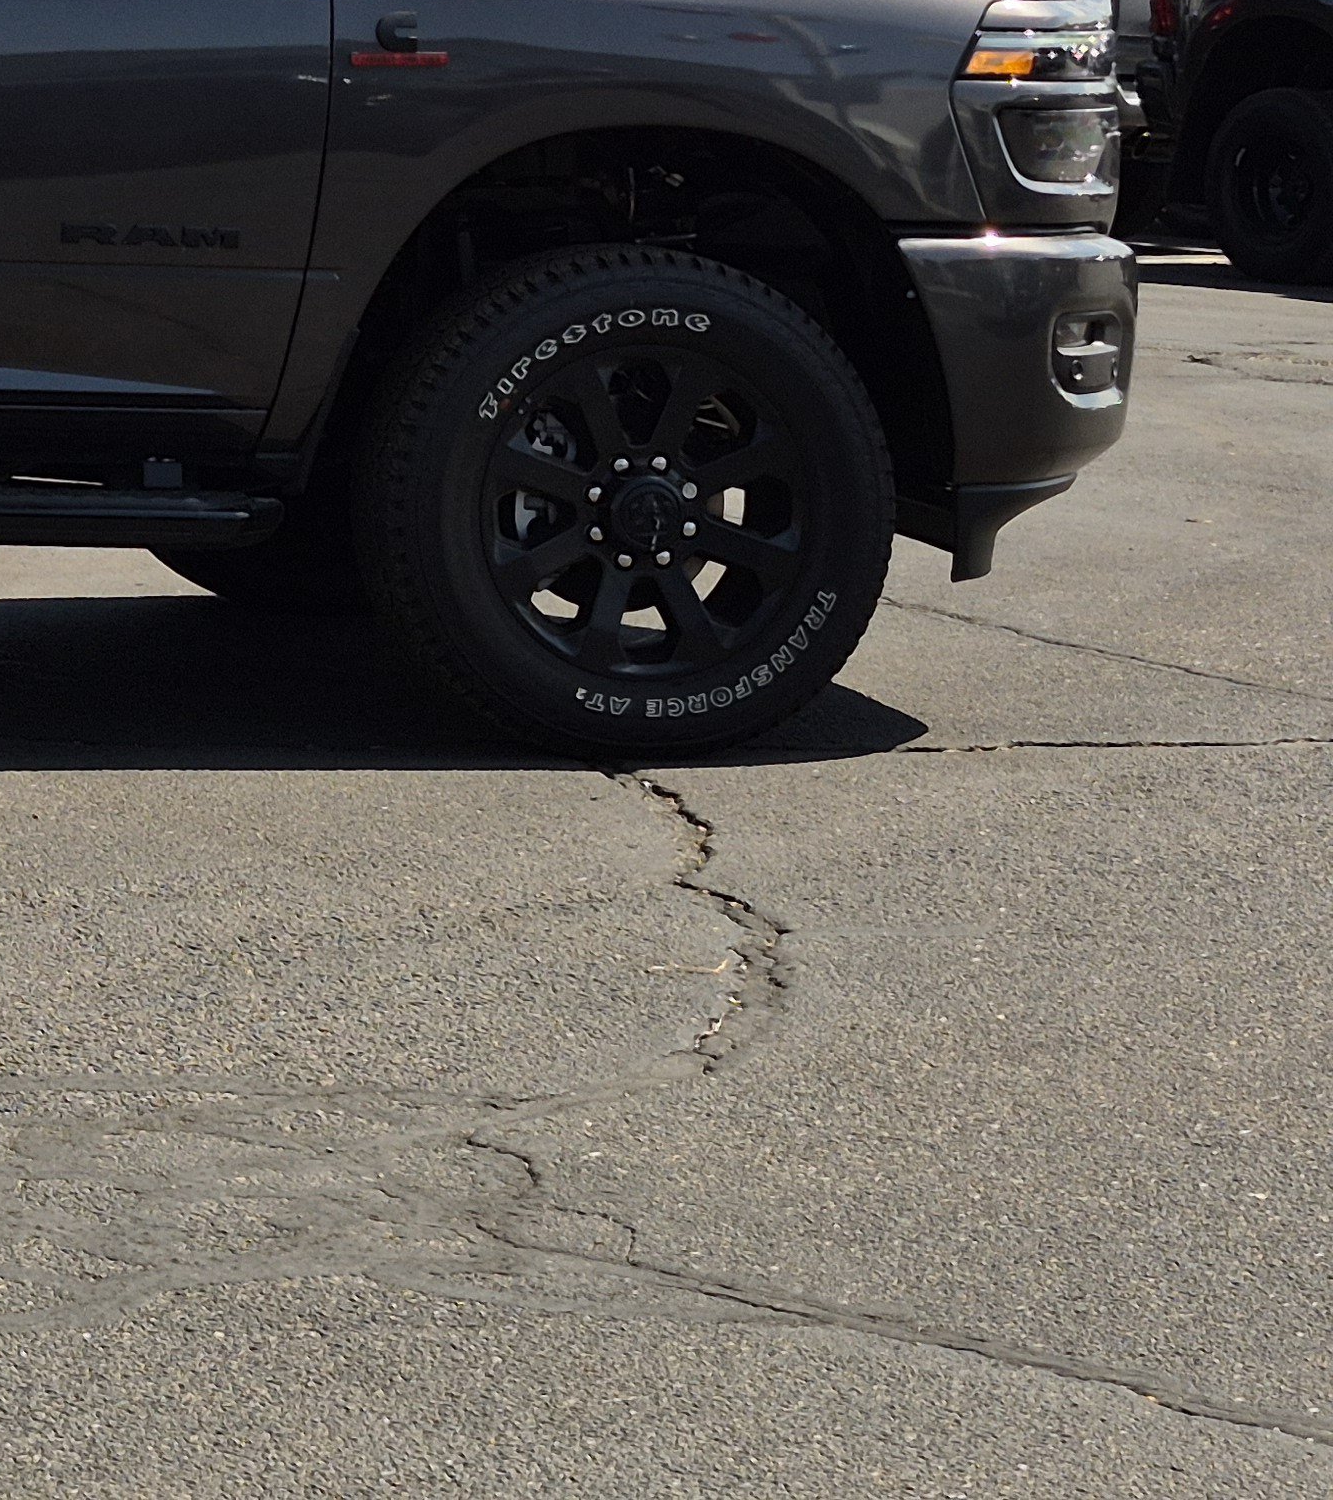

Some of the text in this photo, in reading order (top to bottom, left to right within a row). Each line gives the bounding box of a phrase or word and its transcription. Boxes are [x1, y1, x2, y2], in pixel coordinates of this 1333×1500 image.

[60, 221, 240, 249] RAM
[478, 308, 711, 420] Firestone
[645, 590, 837, 718] TRANSFORCE
